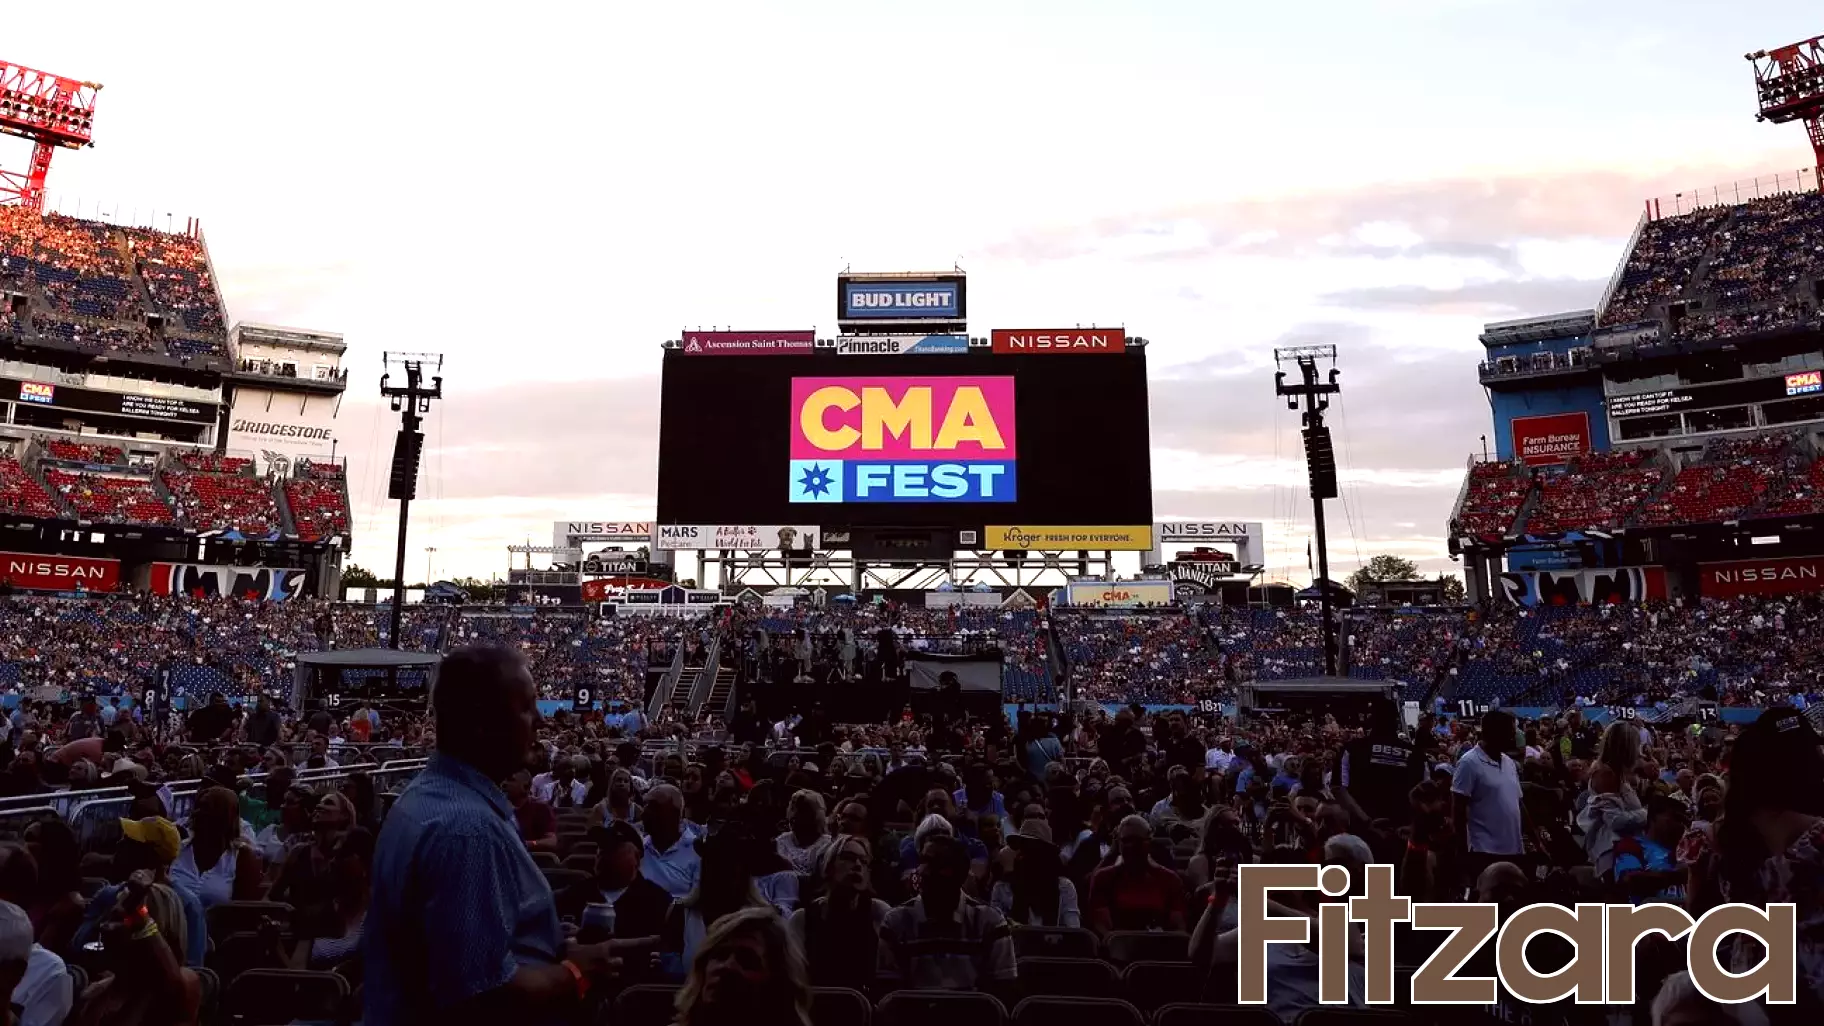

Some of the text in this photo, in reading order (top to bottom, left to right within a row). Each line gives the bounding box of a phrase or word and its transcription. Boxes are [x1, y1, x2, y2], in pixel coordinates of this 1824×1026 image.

[852, 292, 952, 307] BUD LIGHT
[705, 339, 813, 349] Ascension Saint Thomas
[839, 338, 900, 353] Pinnacle
[1009, 335, 1108, 348] NISSAN
[1787, 373, 1821, 387] CMA
[22, 383, 53, 397] CMA
[800, 386, 1006, 451] CMA
[231, 419, 333, 440] BRIDGESTONE
[1522, 433, 1580, 445] Farm Bureau
[1522, 441, 1581, 455] INSURANCE
[856, 464, 1005, 498] FEST
[568, 522, 650, 534] NISSAN
[661, 526, 699, 538] MARS
[1162, 523, 1247, 534] NISSAN
[1003, 527, 1041, 548] Kroger
[1045, 533, 1070, 542] FRESH
[1071, 533, 1088, 542] FOR
[9, 560, 105, 579] NISSAN
[601, 561, 637, 572] TITAN
[1193, 563, 1231, 572] TITAN
[1715, 565, 1817, 583] NISSAN
[1102, 591, 1130, 601] CMA
[328, 693, 340, 706] 15
[578, 688, 590, 705] 9
[1199, 699, 1213, 712] 18
[1457, 699, 1475, 717] 11
[1621, 706, 1636, 719] 19
[1372, 744, 1413, 758] BEST
